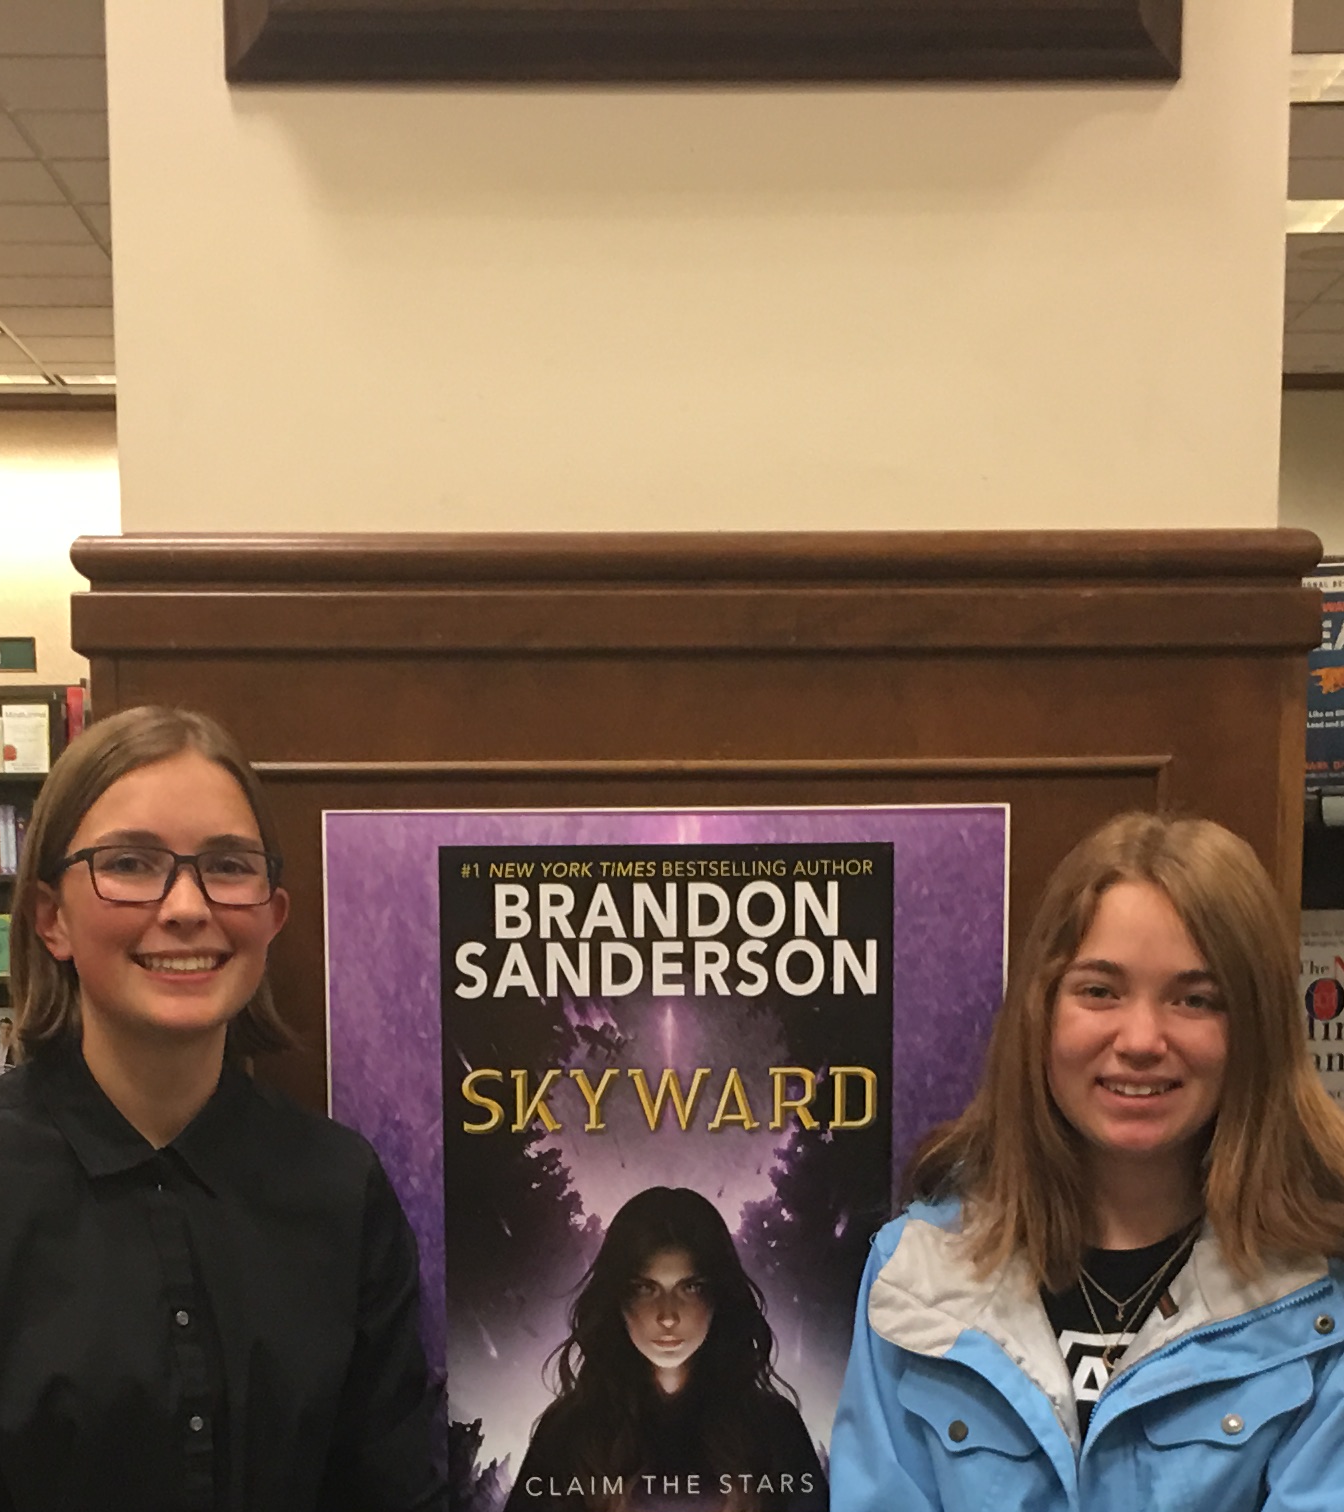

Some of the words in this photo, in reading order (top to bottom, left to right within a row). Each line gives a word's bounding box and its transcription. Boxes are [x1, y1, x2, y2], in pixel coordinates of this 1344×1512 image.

[460, 863, 481, 879] #1
[489, 862, 536, 878] NEW
[541, 861, 593, 878] YORK
[599, 861, 657, 878] TIMES
[662, 860, 787, 877] BESTSELLING
[793, 859, 874, 876] AUTHOR
[494, 880, 840, 939] BRANDON
[455, 938, 879, 999] SANDERSON
[460, 1066, 878, 1134] SKYWARD
[525, 1475, 624, 1498] CLAIM
[642, 1474, 701, 1495] THE
[718, 1472, 816, 1495] STARS
